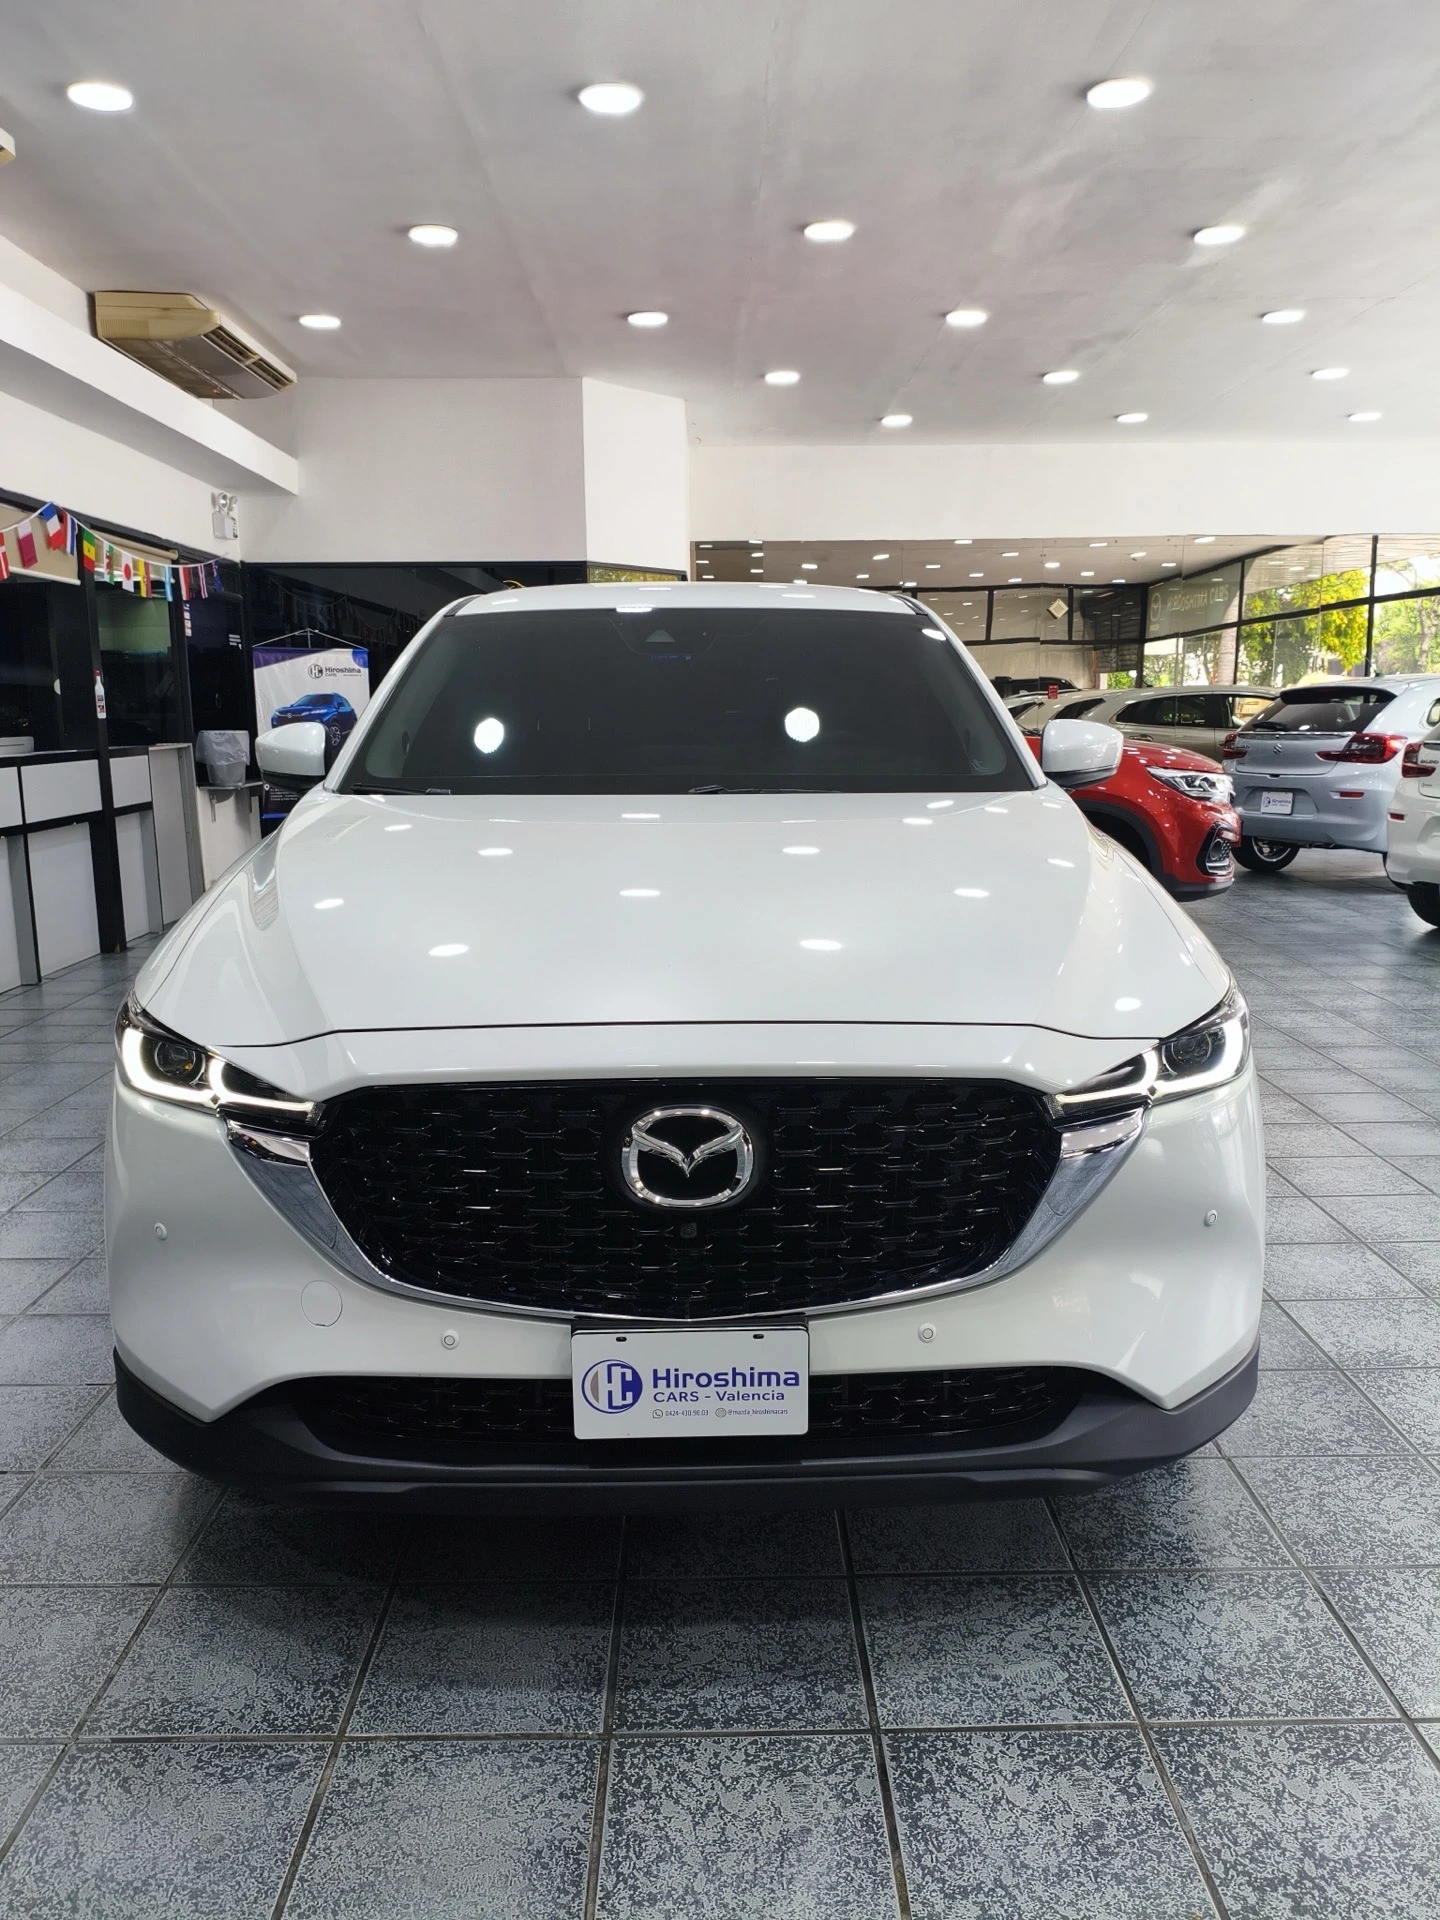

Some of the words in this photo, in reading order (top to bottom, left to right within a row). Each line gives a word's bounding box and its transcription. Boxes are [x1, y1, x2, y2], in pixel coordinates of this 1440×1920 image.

[325, 666, 361, 674] Hiroshima
[652, 1366, 800, 1388] Hiroshima
[653, 1391, 699, 1403] CARS
[715, 1389, 785, 1402] Valencia
